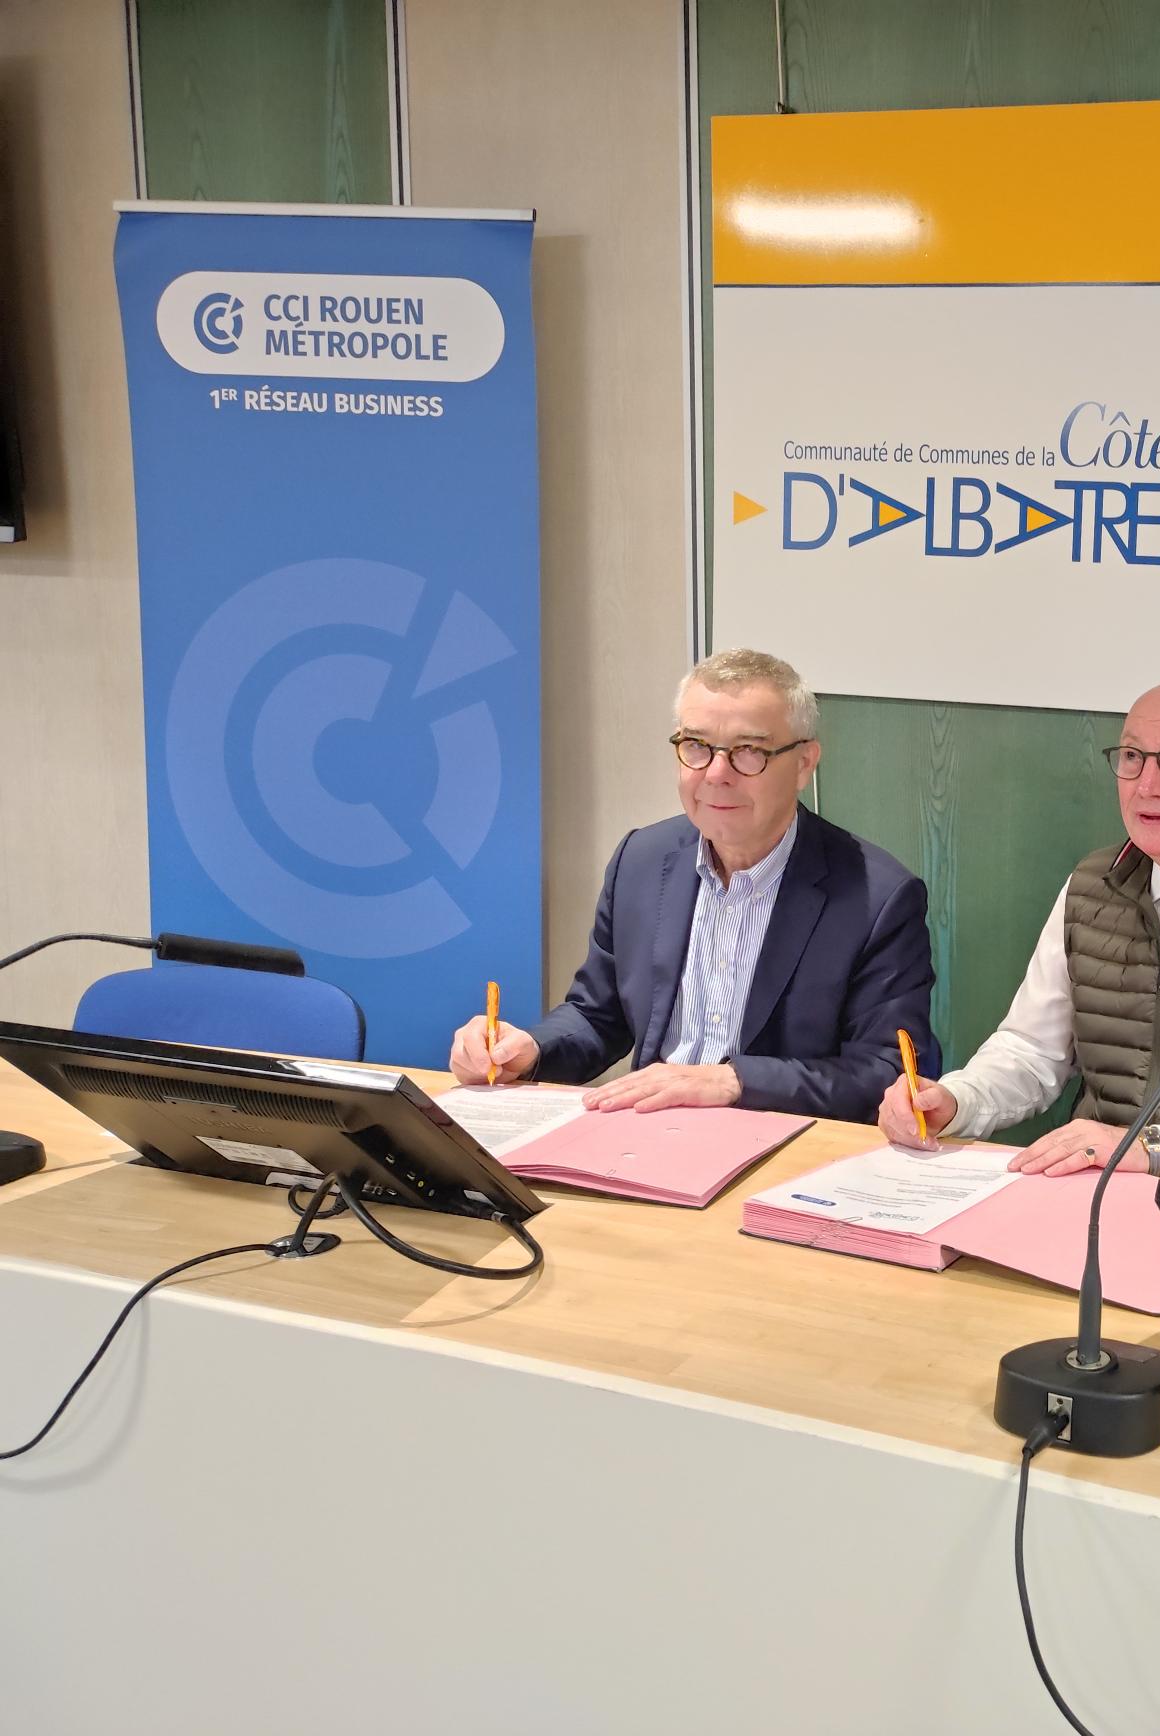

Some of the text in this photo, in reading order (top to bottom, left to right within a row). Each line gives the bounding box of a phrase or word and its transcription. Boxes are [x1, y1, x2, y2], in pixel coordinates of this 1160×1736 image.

[264, 294, 423, 324] CCI ROUEN
[265, 322, 448, 360] MÉTROPOLE
[244, 385, 328, 413] RÉSEAU
[334, 393, 444, 417] BUSINESS
[783, 440, 888, 463] Communauté
[893, 443, 914, 463] de
[918, 444, 1010, 466] Communes
[1015, 446, 1036, 467] de
[1041, 447, 1056, 467] la
